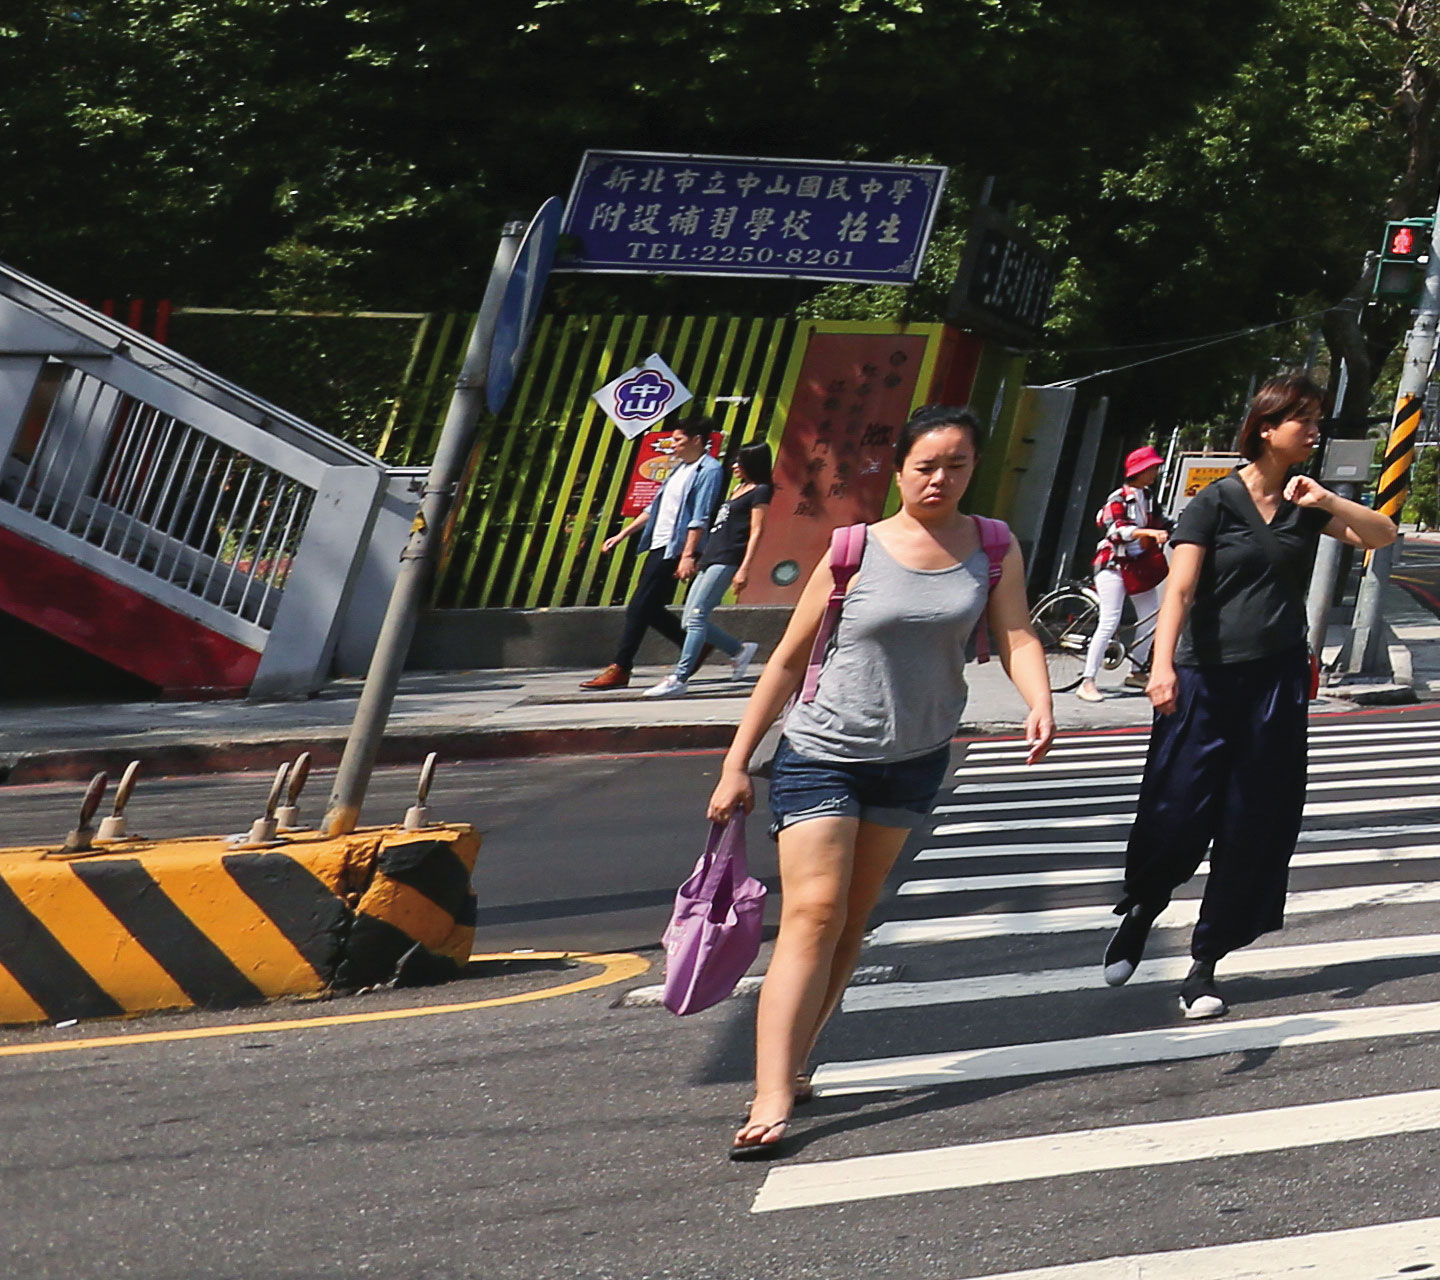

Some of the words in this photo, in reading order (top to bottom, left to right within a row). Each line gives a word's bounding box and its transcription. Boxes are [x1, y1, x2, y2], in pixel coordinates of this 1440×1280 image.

[603, 164, 913, 205] 新北市立中山國民中學
[589, 202, 812, 242] 附設補習學校
[838, 211, 901, 243] 招生
[628, 242, 853, 266] TEL:2250-8261
